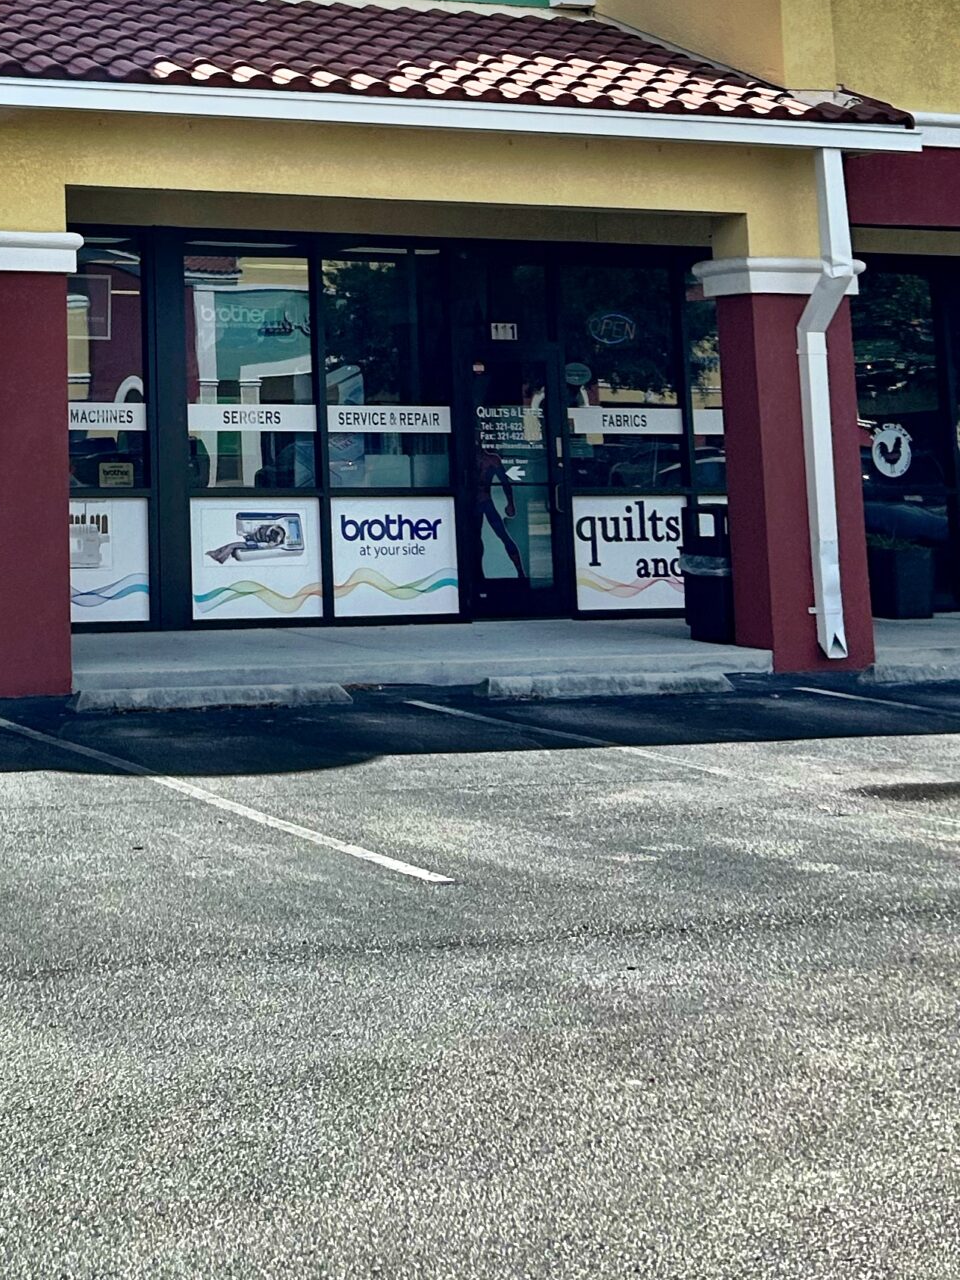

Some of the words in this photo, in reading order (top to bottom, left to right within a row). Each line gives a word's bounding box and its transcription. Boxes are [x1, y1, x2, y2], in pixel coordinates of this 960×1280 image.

[493, 324, 516, 339] 111
[70, 408, 134, 425] MACHINES
[222, 410, 282, 426] SERGERS
[338, 411, 387, 426] SERVICE
[389, 412, 398, 426] &
[399, 412, 440, 427] REPAIR
[476, 406, 510, 418] QUILTS
[602, 414, 647, 427] FABRICS
[340, 514, 442, 541] brother
[576, 500, 681, 567] quilts
[360, 546, 371, 556] at
[374, 546, 400, 559] your
[402, 543, 426, 556] side
